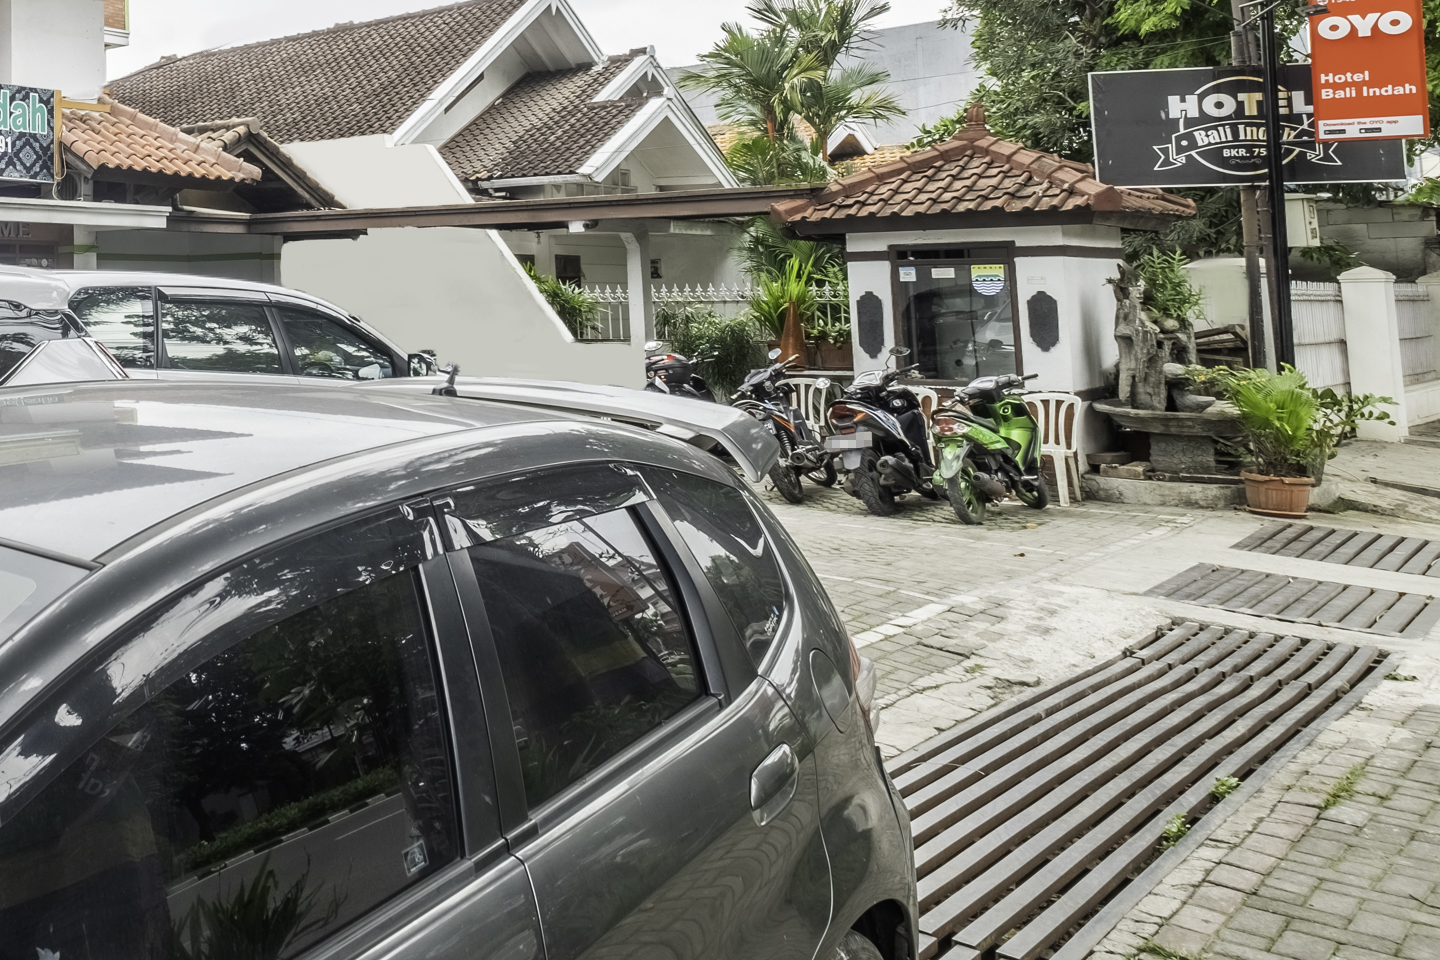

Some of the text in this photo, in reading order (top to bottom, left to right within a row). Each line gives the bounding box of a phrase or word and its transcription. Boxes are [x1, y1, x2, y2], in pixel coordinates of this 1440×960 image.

[1317, 10, 1413, 40] OYO
[1320, 70, 1369, 84] Hotel
[1321, 83, 1417, 99] Bali Indah
[1193, 125, 1233, 146] Bali
[1223, 148, 1267, 157] BKR. 75
